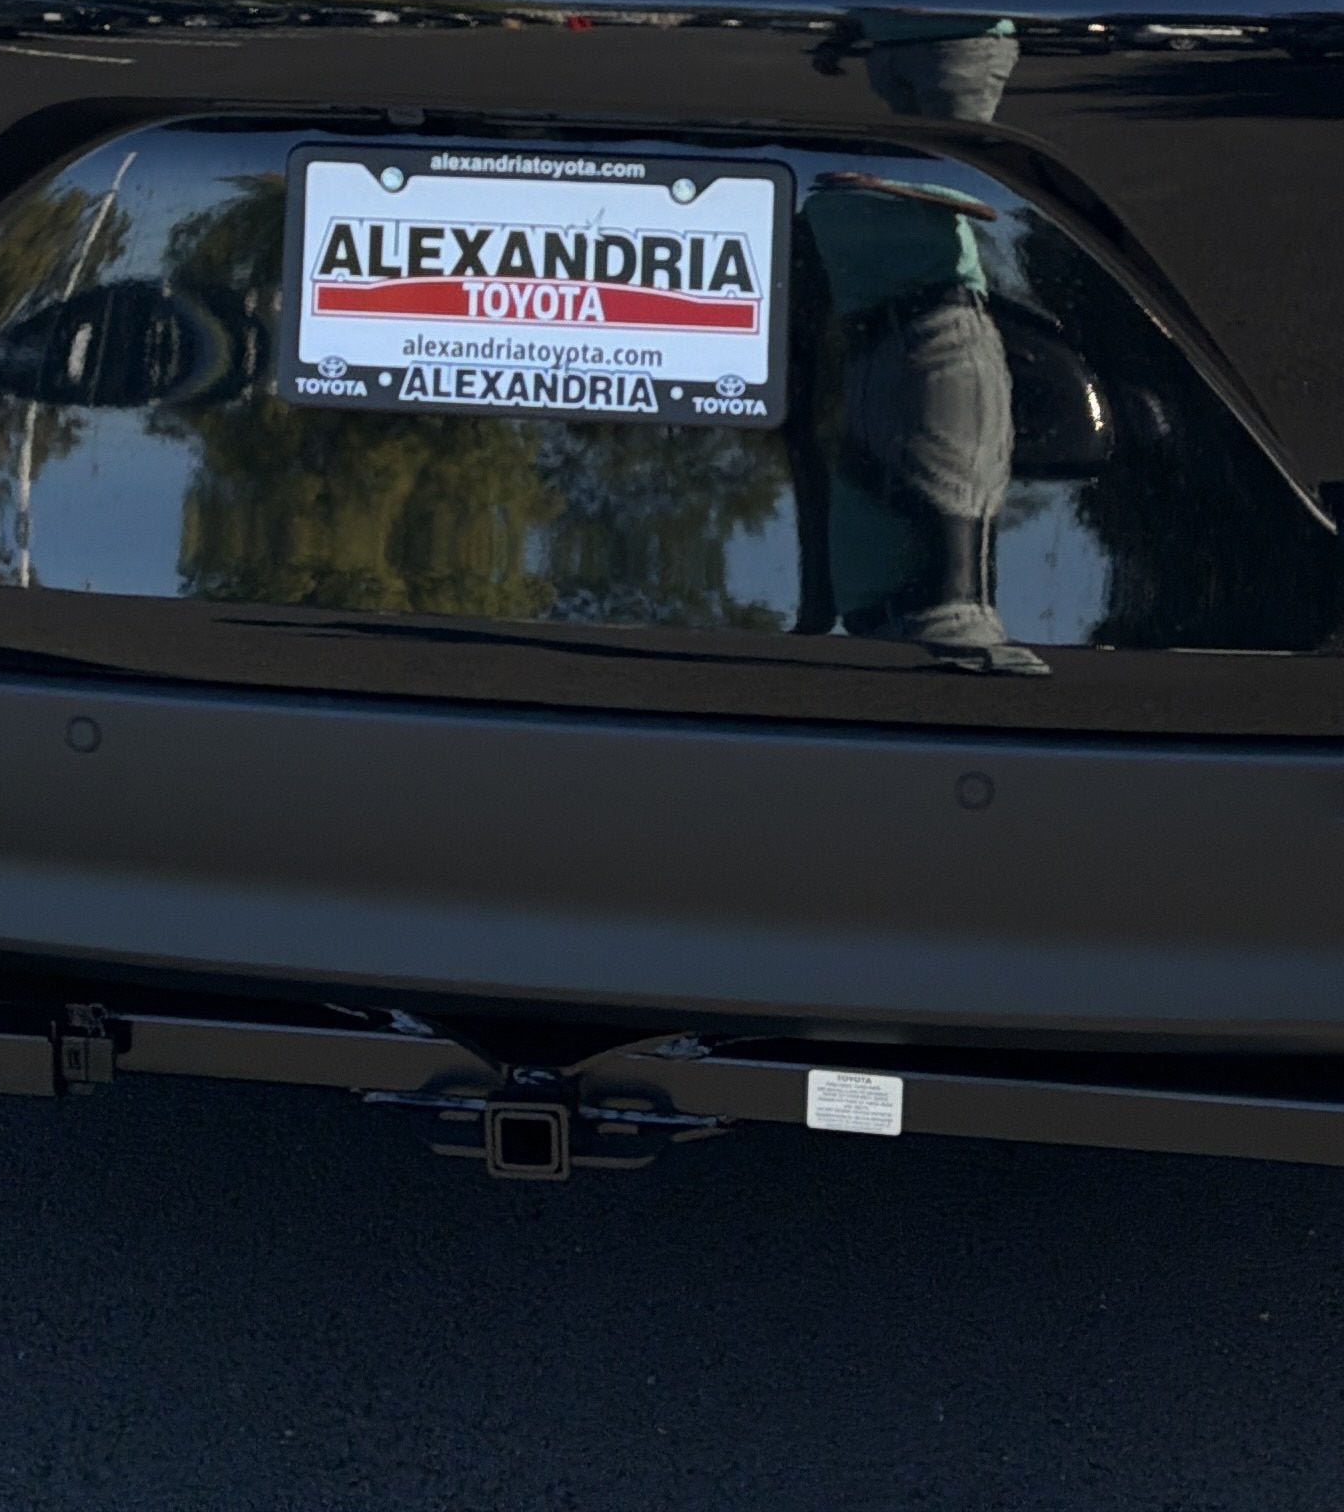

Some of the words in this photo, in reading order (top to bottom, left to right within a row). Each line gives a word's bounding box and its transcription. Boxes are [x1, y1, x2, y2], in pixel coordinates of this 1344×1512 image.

[430, 151, 646, 179] alexandriatoyota.com
[319, 222, 755, 294] ALEXANDRIA
[462, 282, 606, 322] TOYOTA
[402, 334, 663, 369] alexandriatoyota.com
[295, 376, 368, 397] TOYOTA
[403, 365, 655, 409] ALEXANDRIA
[692, 396, 768, 416] TOYOTA
